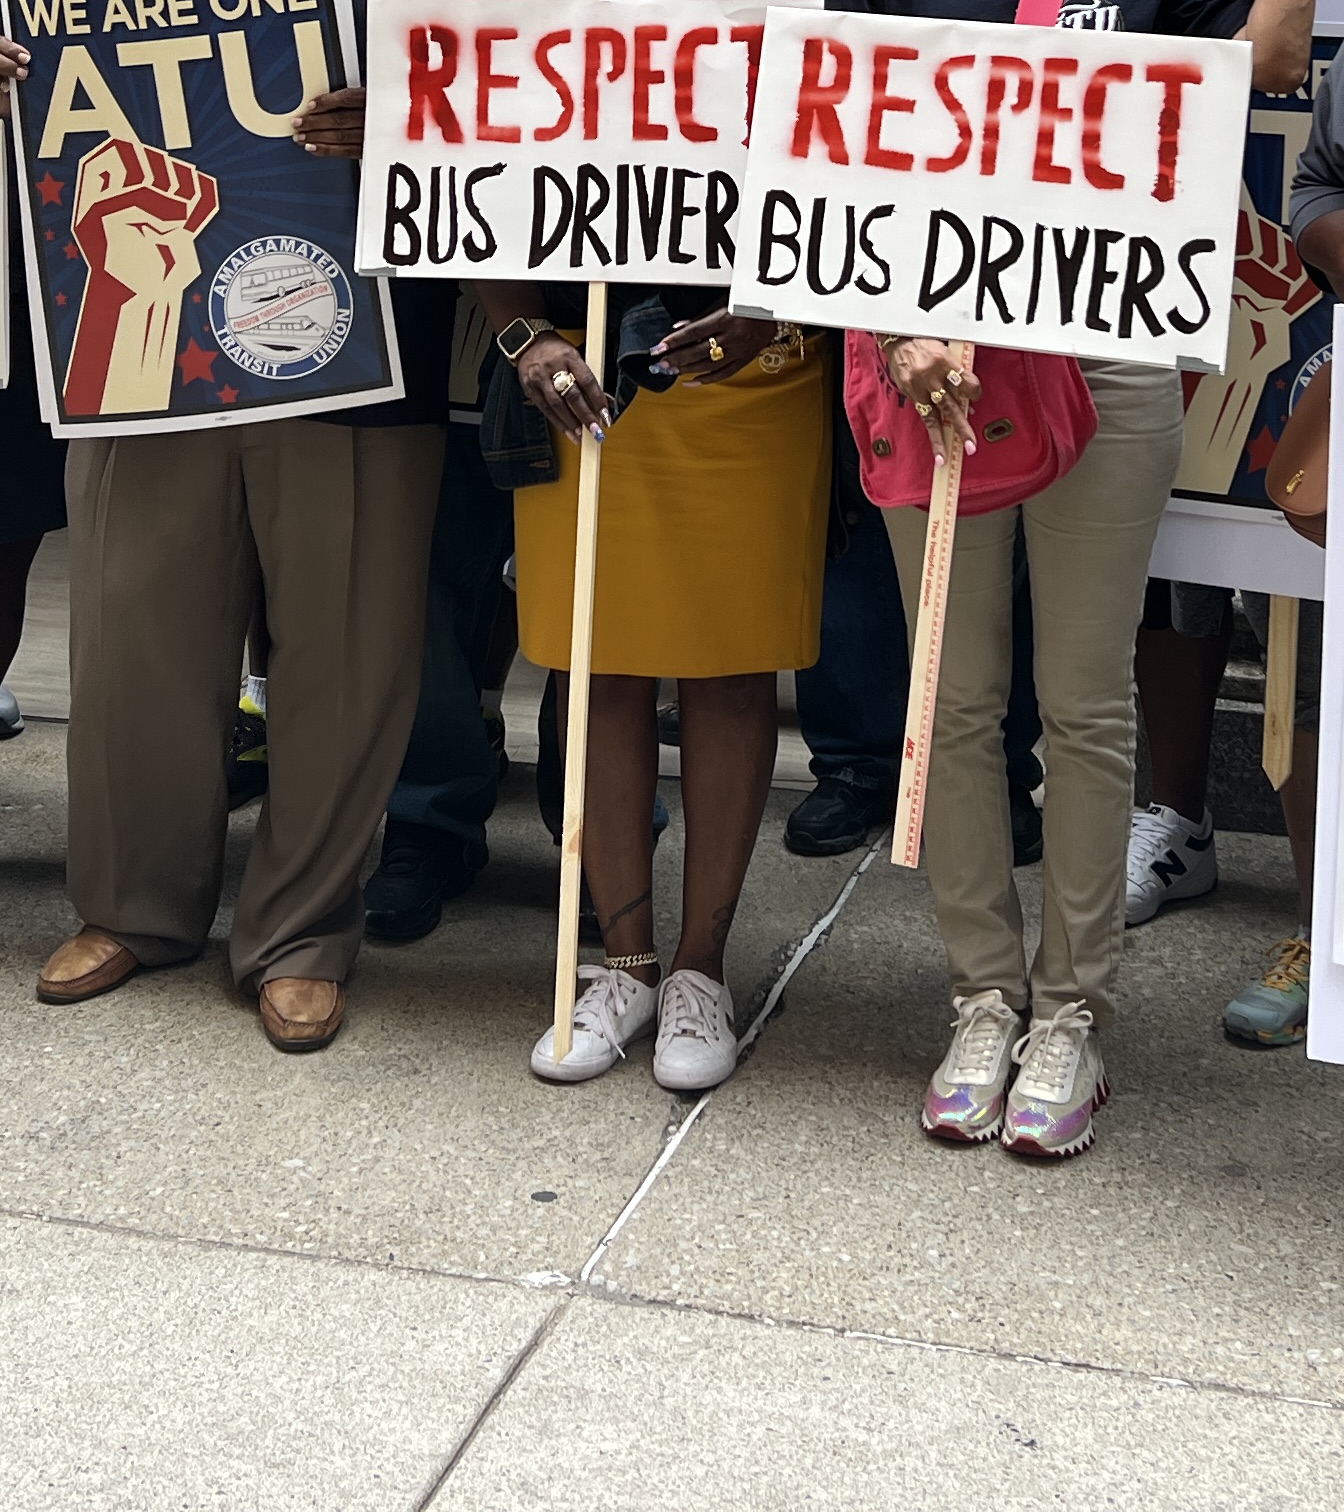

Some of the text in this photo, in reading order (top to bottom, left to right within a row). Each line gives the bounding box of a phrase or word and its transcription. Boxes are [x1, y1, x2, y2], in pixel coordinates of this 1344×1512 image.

[37, 20, 331, 159] ATU
[789, 37, 1204, 204] RESPECT
[213, 238, 339, 298] AMALGAMATED
[383, 162, 507, 267] BUS
[758, 189, 1217, 340] BUS DRIVERS
[217, 308, 351, 376] TRANSIT UNION
